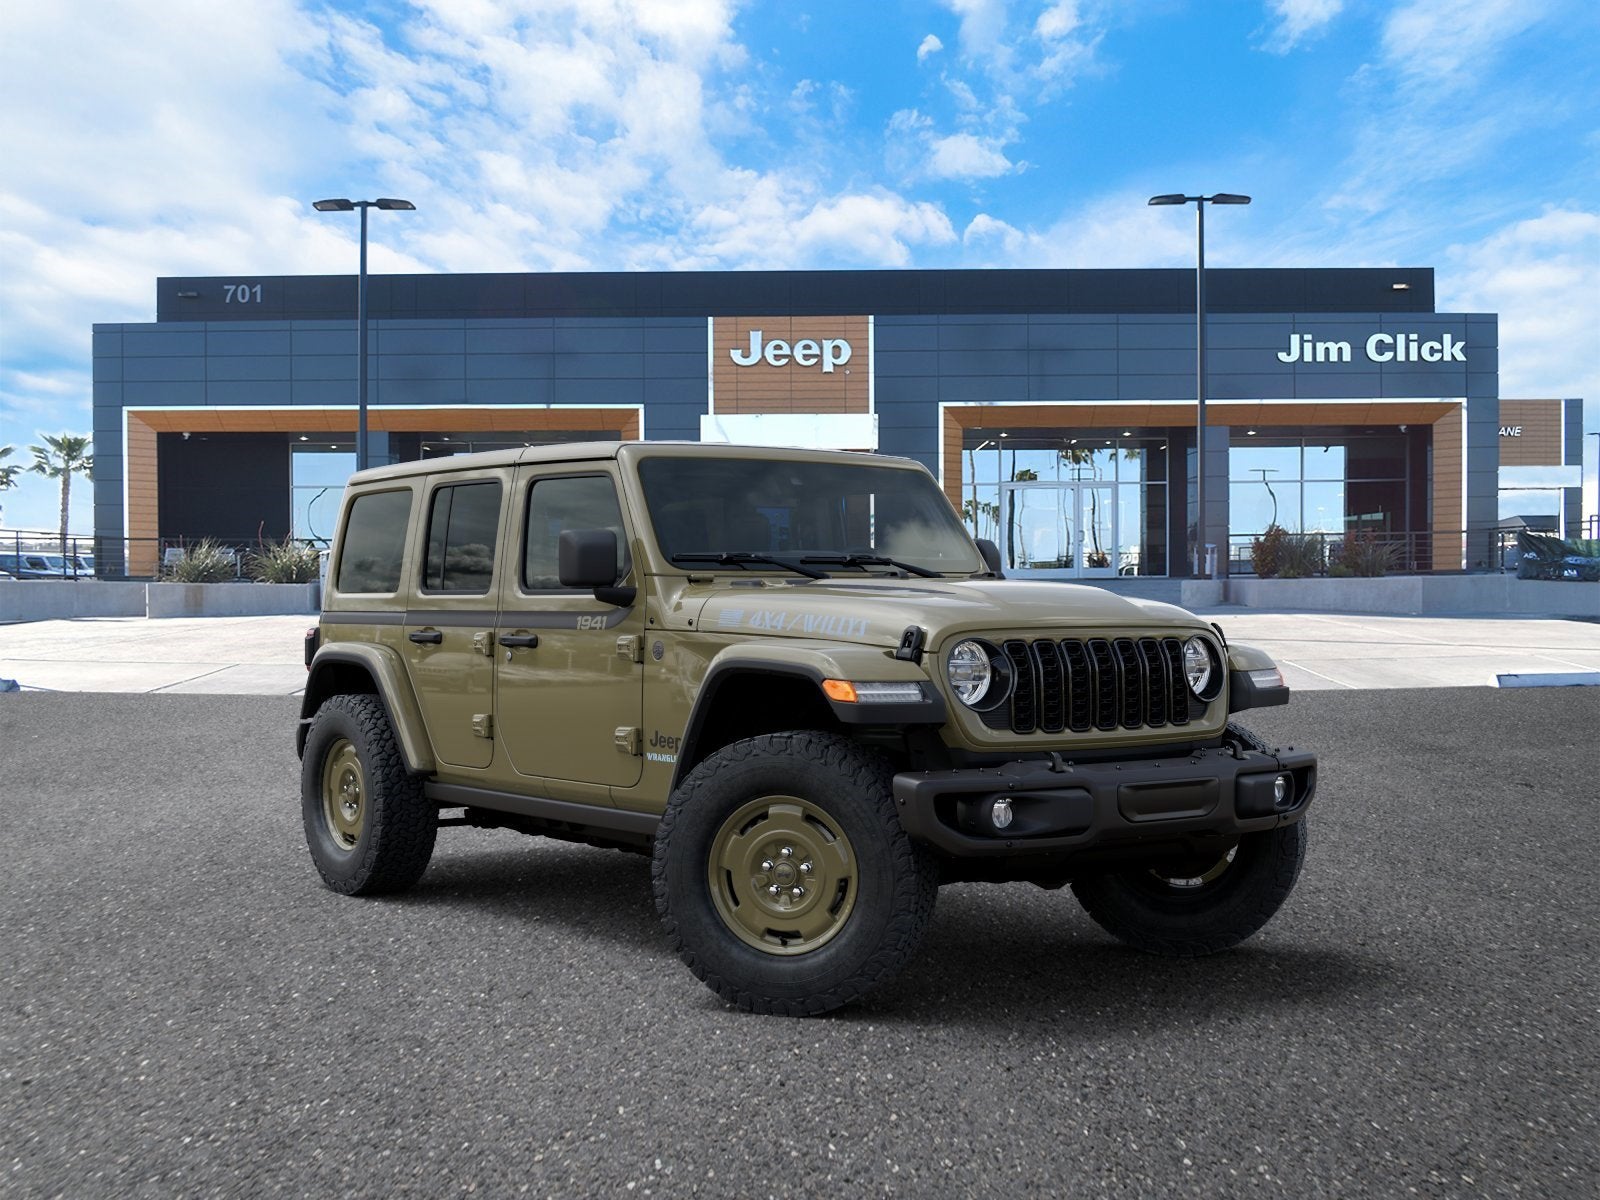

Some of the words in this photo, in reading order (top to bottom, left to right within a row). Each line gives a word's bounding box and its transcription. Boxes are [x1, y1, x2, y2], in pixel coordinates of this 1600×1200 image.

[223, 284, 262, 303] 701
[729, 329, 852, 374] Jeep
[1277, 333, 1352, 363] Jim
[1365, 333, 1467, 363] Click
[576, 615, 608, 630] 1941
